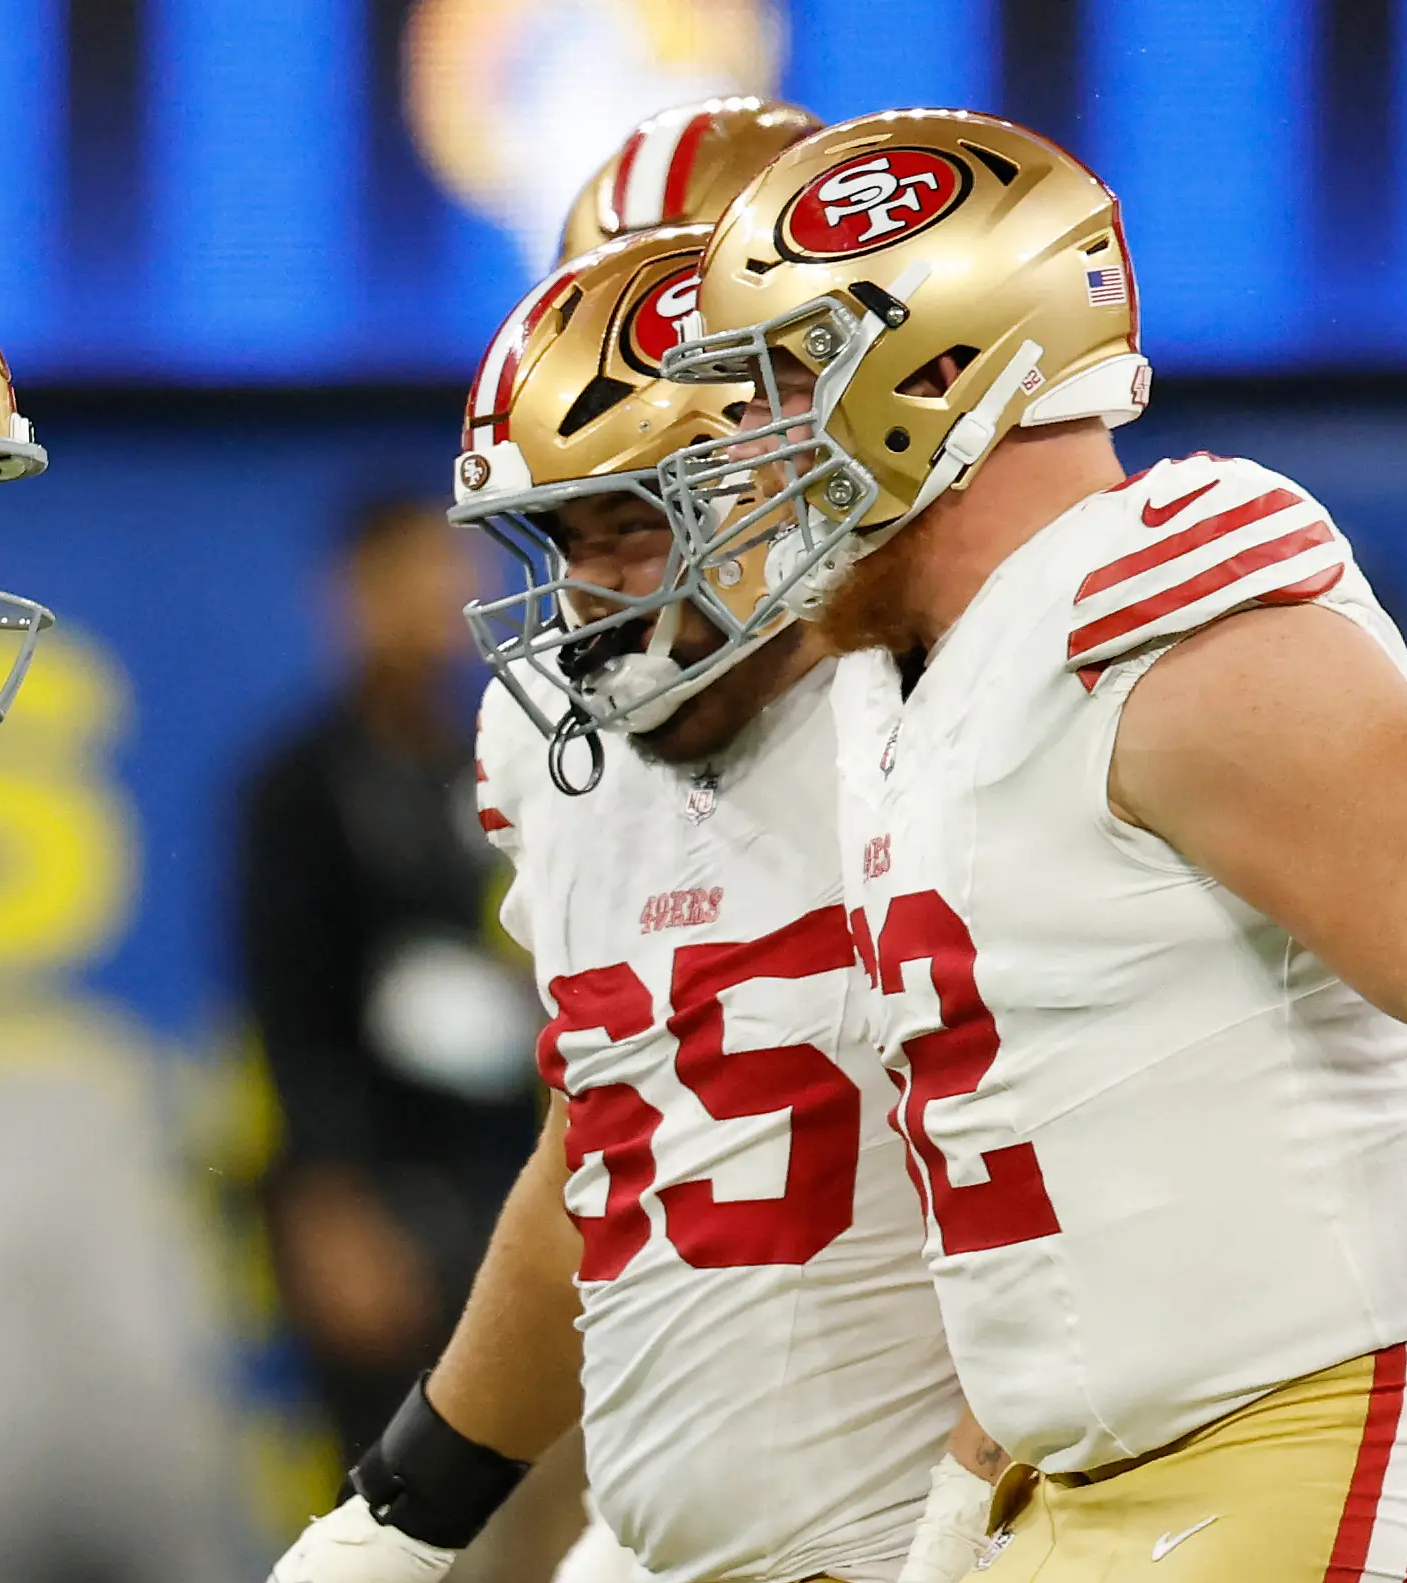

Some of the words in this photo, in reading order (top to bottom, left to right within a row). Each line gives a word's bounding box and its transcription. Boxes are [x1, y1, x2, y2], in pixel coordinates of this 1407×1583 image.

[816, 156, 939, 243] SF
[640, 885, 725, 935] 49ERS
[536, 903, 861, 1282] 65
